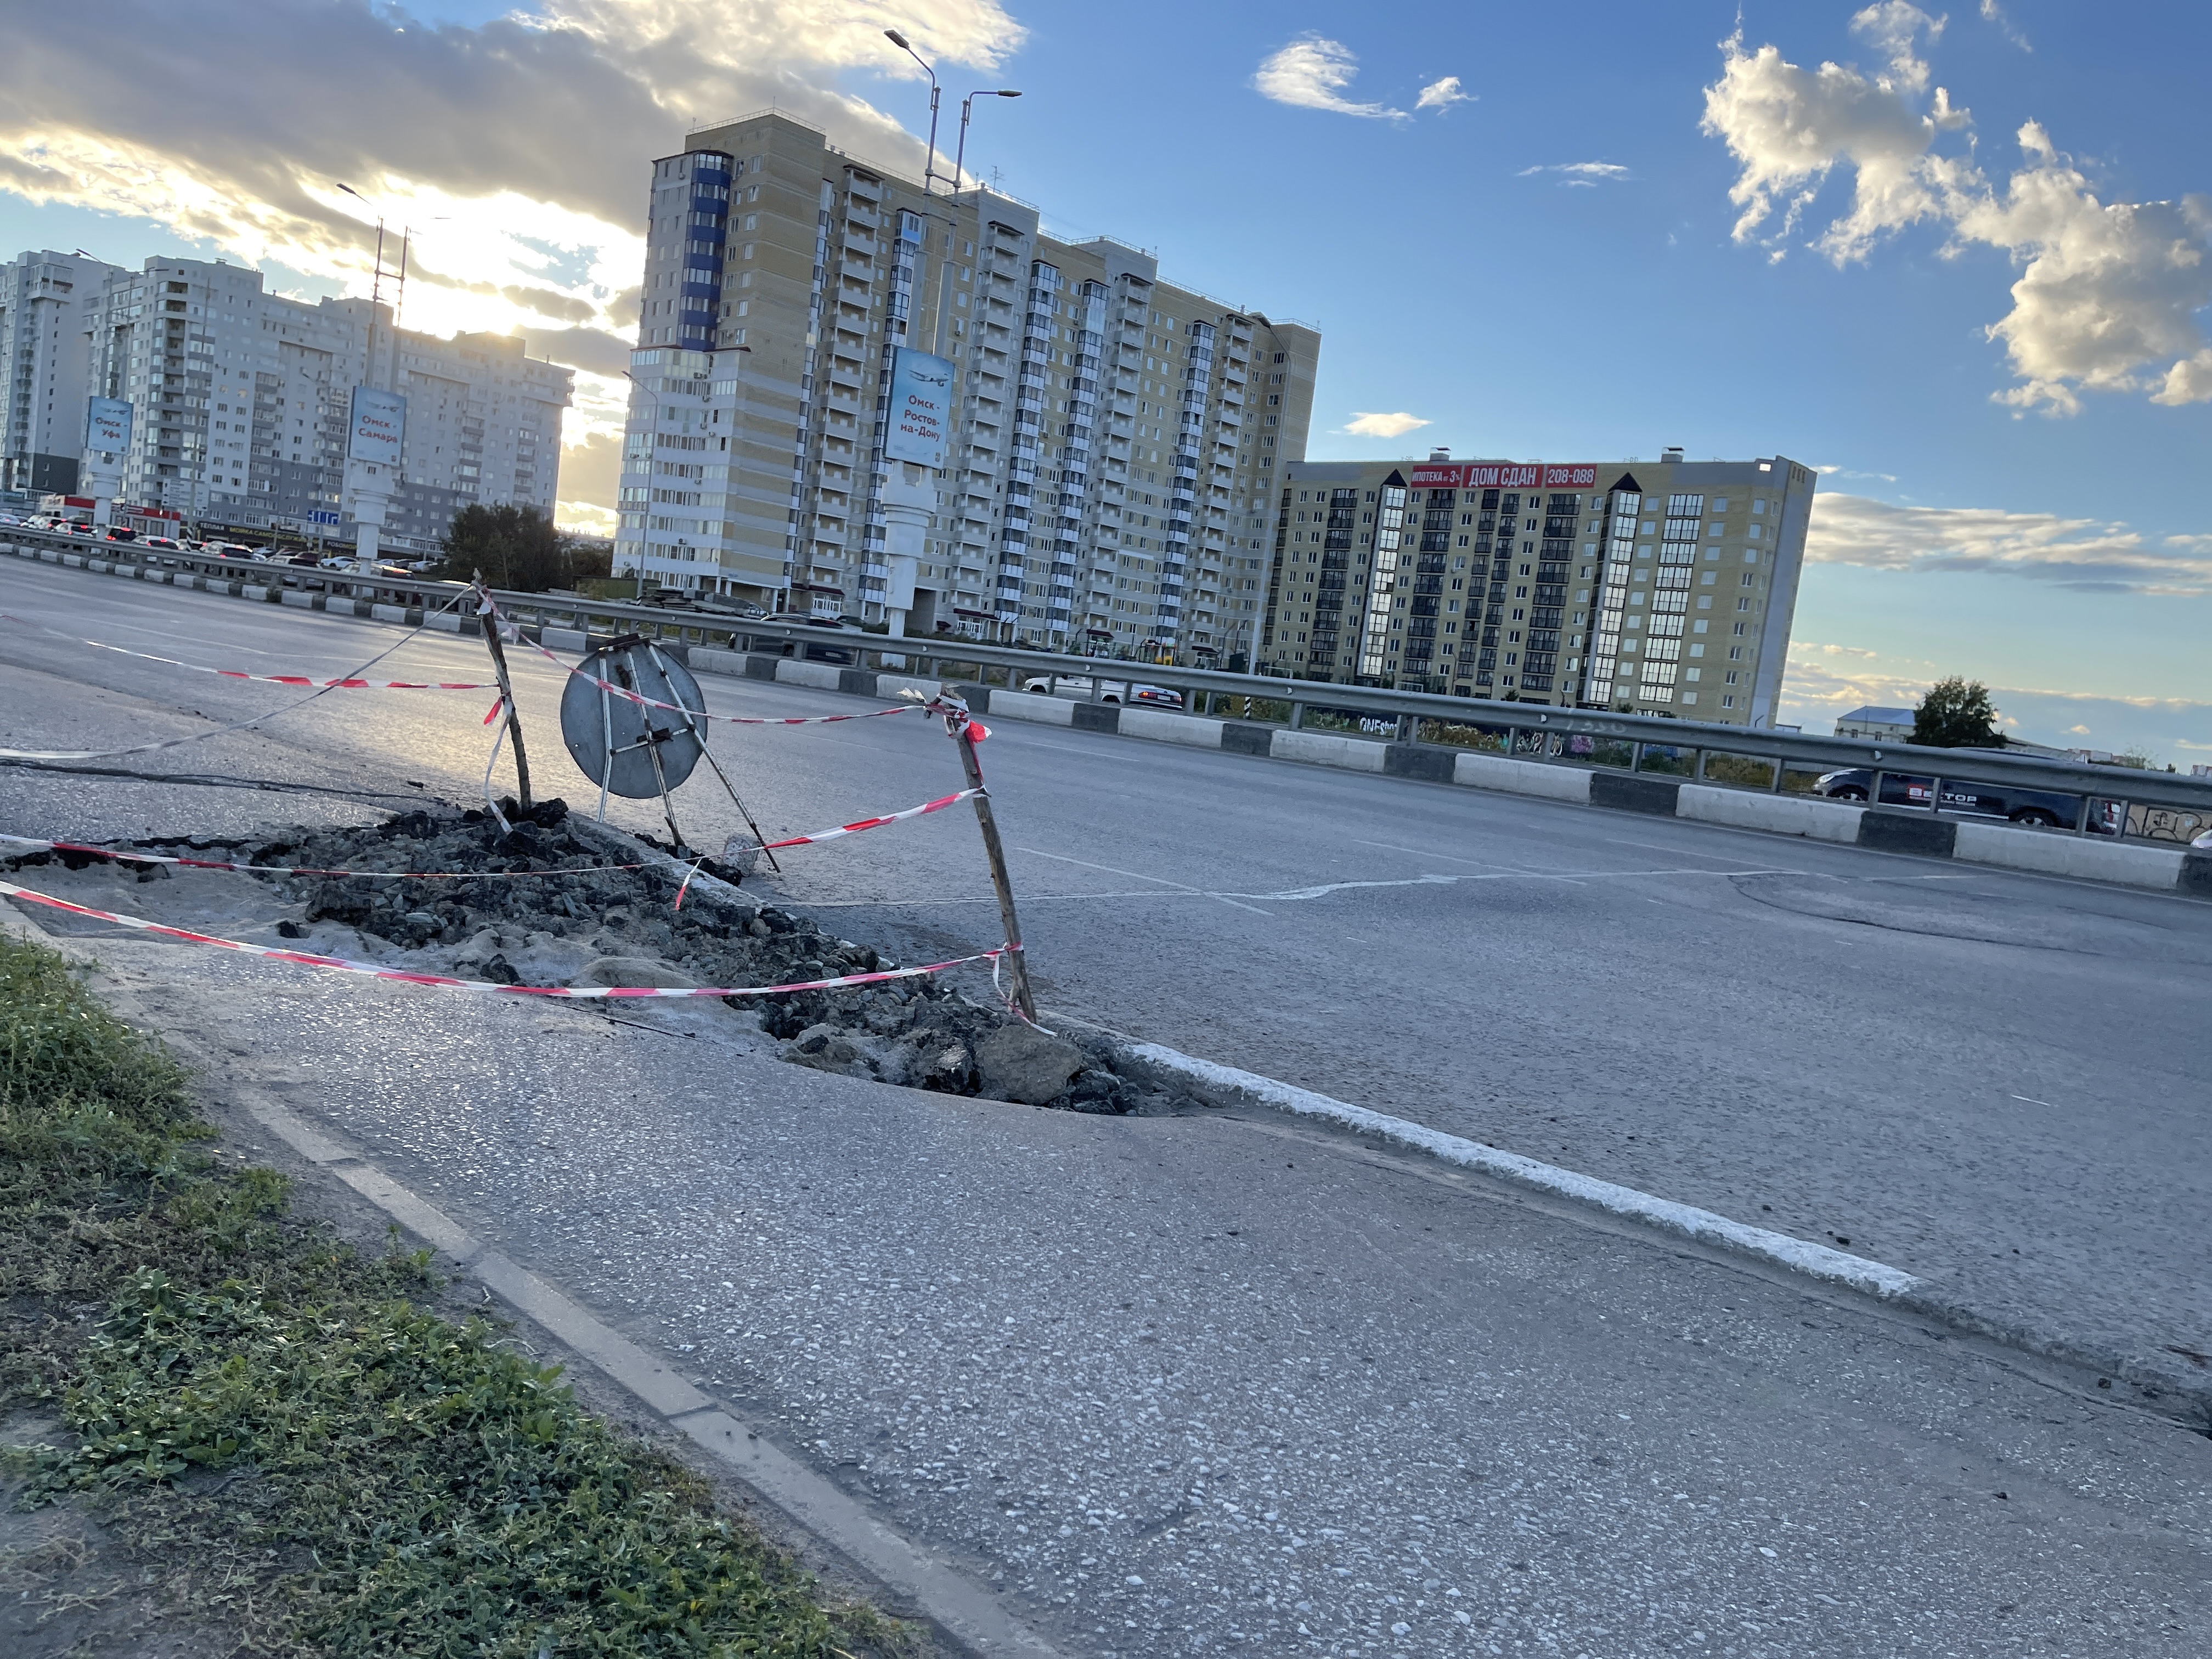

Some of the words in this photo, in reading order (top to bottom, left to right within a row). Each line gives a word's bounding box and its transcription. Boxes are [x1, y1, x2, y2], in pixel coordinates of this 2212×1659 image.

[909, 394, 934, 410] Омск
[362, 415, 390, 428] Омск
[904, 409, 940, 426] Ростов-
[358, 427, 398, 443] Самара
[900, 424, 941, 442] на-Дону
[1412, 471, 1443, 482] ИПОТЕКА
[1469, 467, 1499, 487] ДОМ
[1500, 467, 1537, 487] СДАН
[1548, 469, 1594, 483] 208-088
